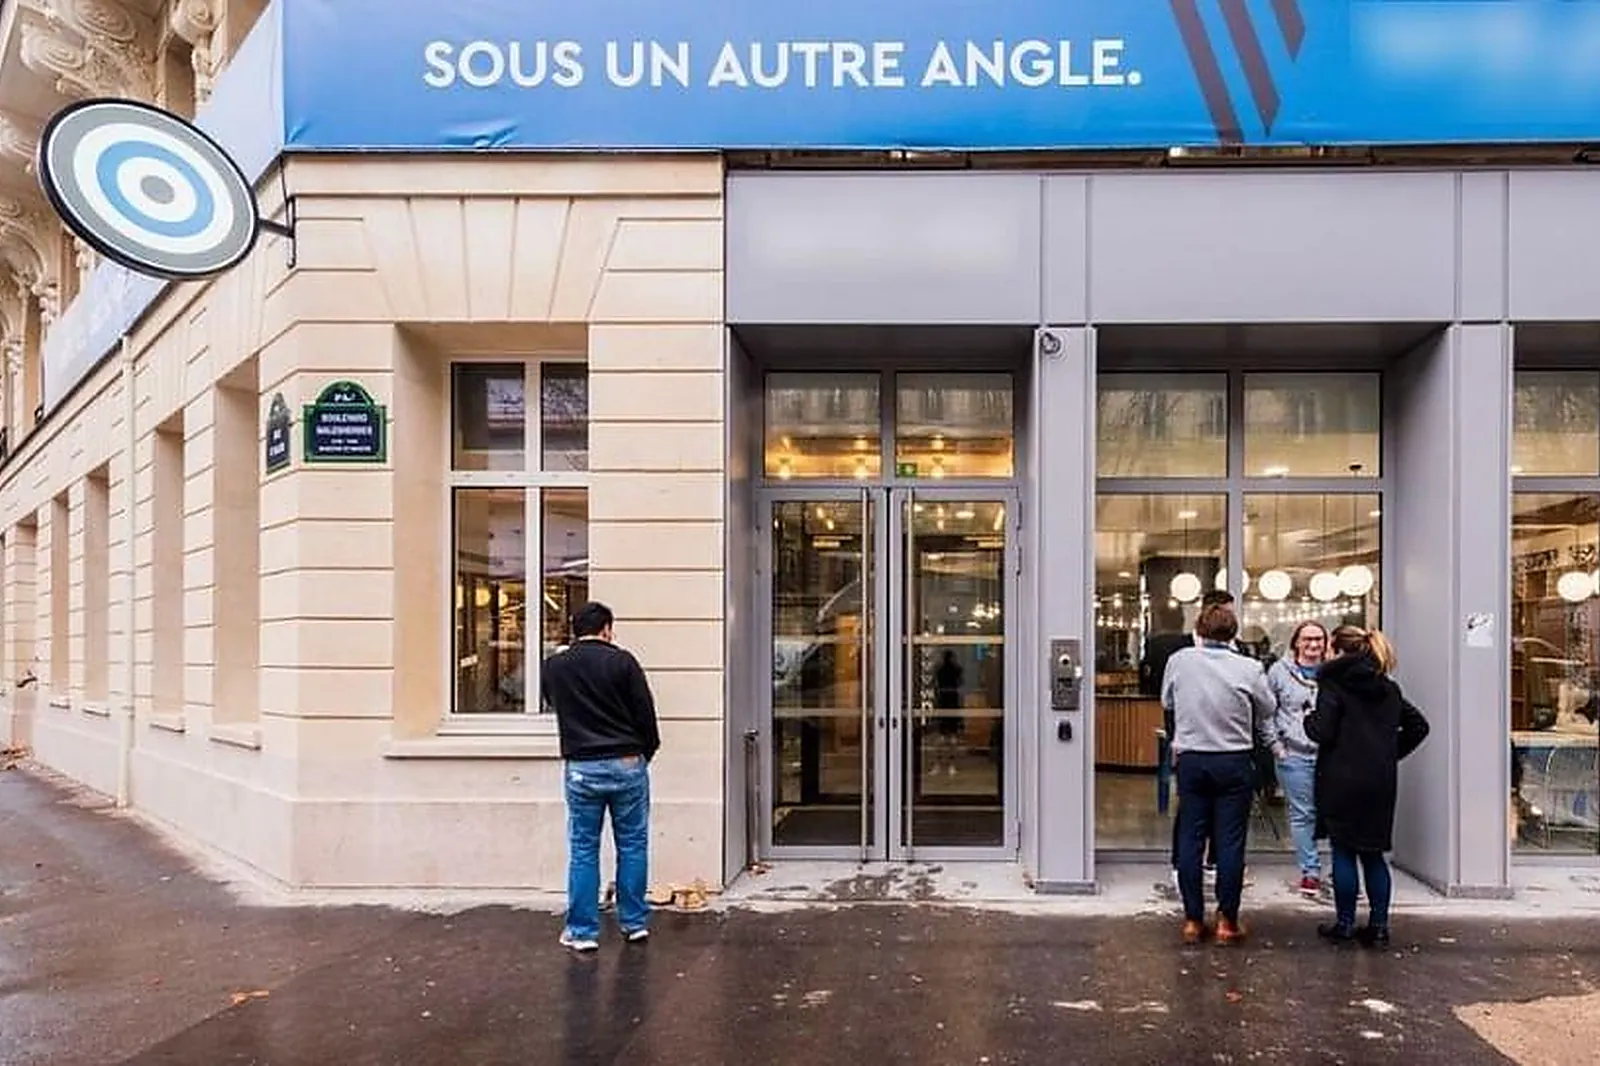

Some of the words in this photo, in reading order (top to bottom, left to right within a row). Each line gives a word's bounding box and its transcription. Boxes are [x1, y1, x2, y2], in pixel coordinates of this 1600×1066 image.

[423, 40, 583, 87] SOUS
[605, 41, 689, 87] UN
[707, 41, 904, 87] AUTRE
[920, 39, 1141, 86] ANGLE.
